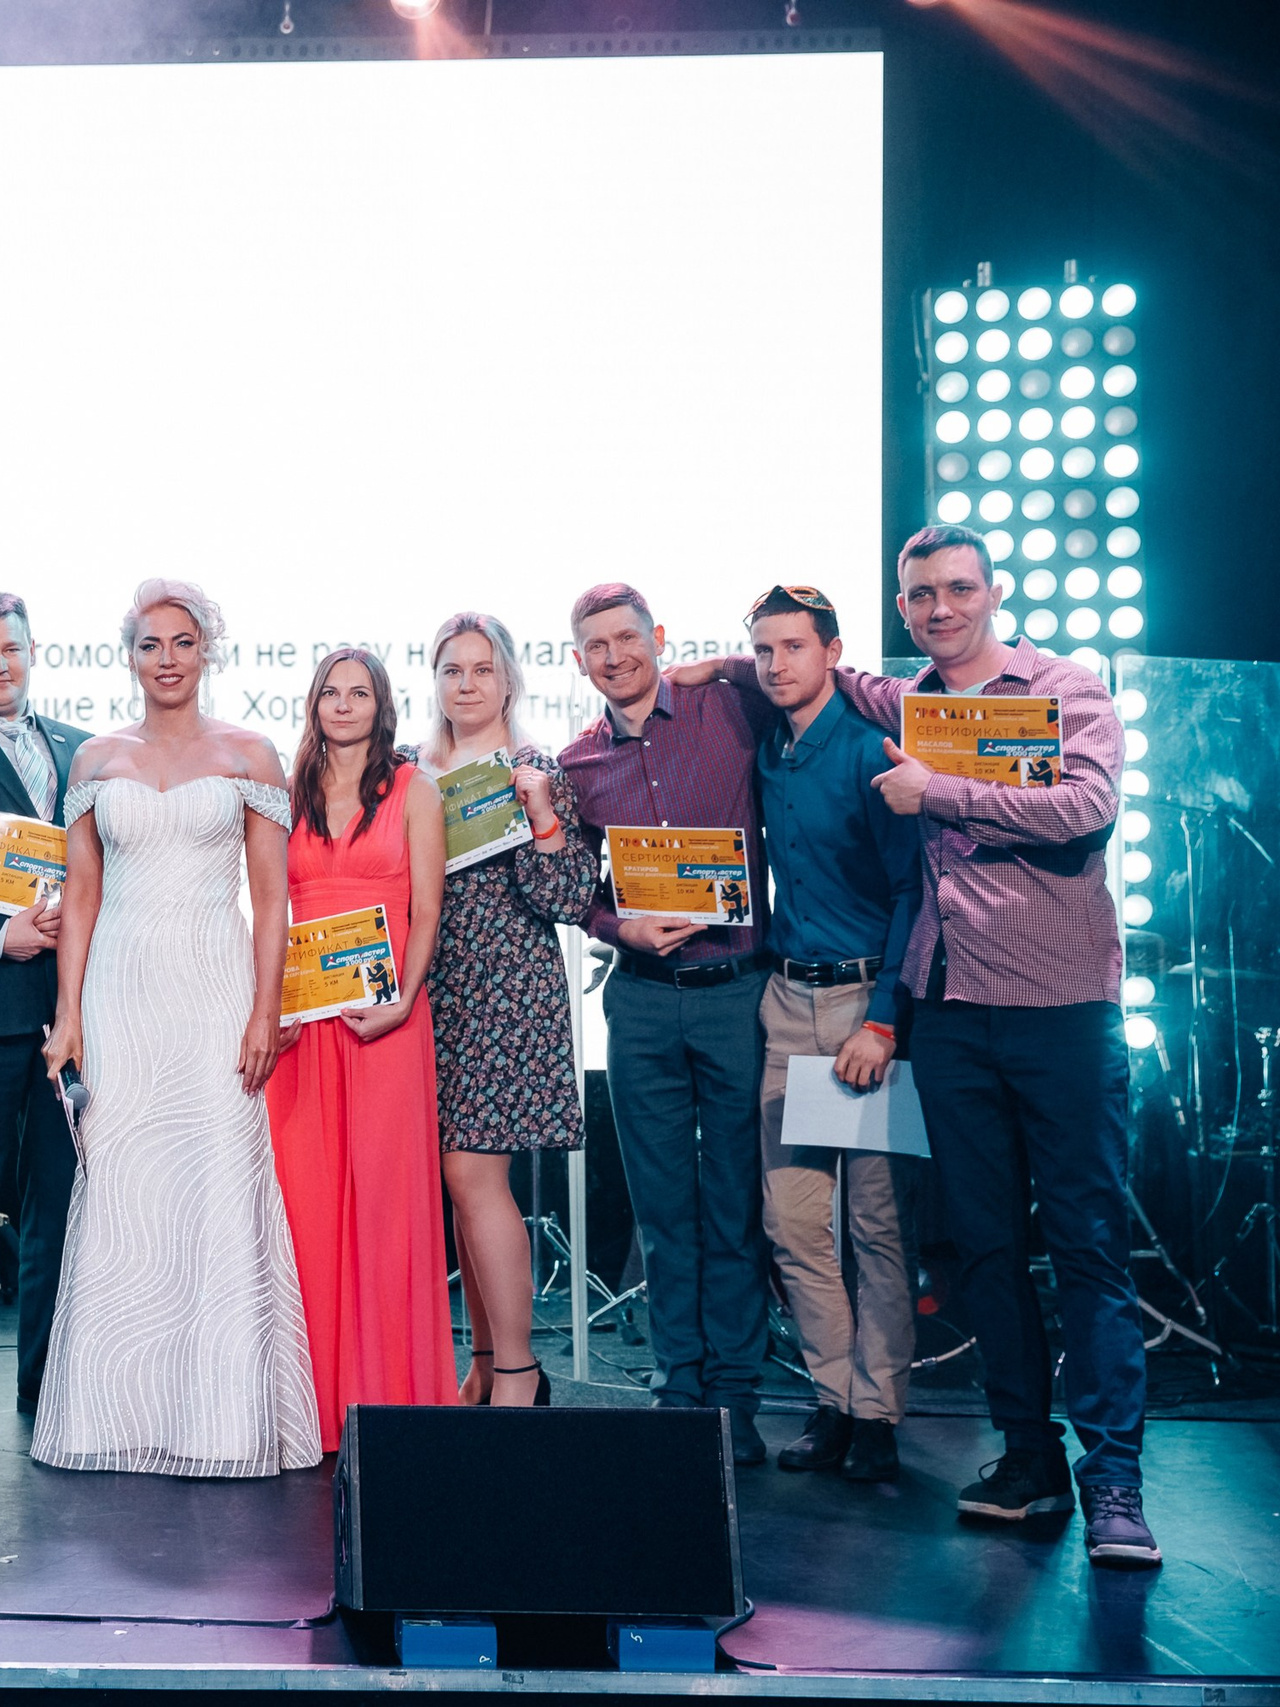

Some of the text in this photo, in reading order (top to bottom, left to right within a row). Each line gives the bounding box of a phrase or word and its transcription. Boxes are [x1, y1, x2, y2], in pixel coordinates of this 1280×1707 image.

[256, 642, 297, 667] не
[916, 725, 1010, 738] СЕРТИФИКАТ
[621, 852, 705, 863] СЕРТИФИКАТ
